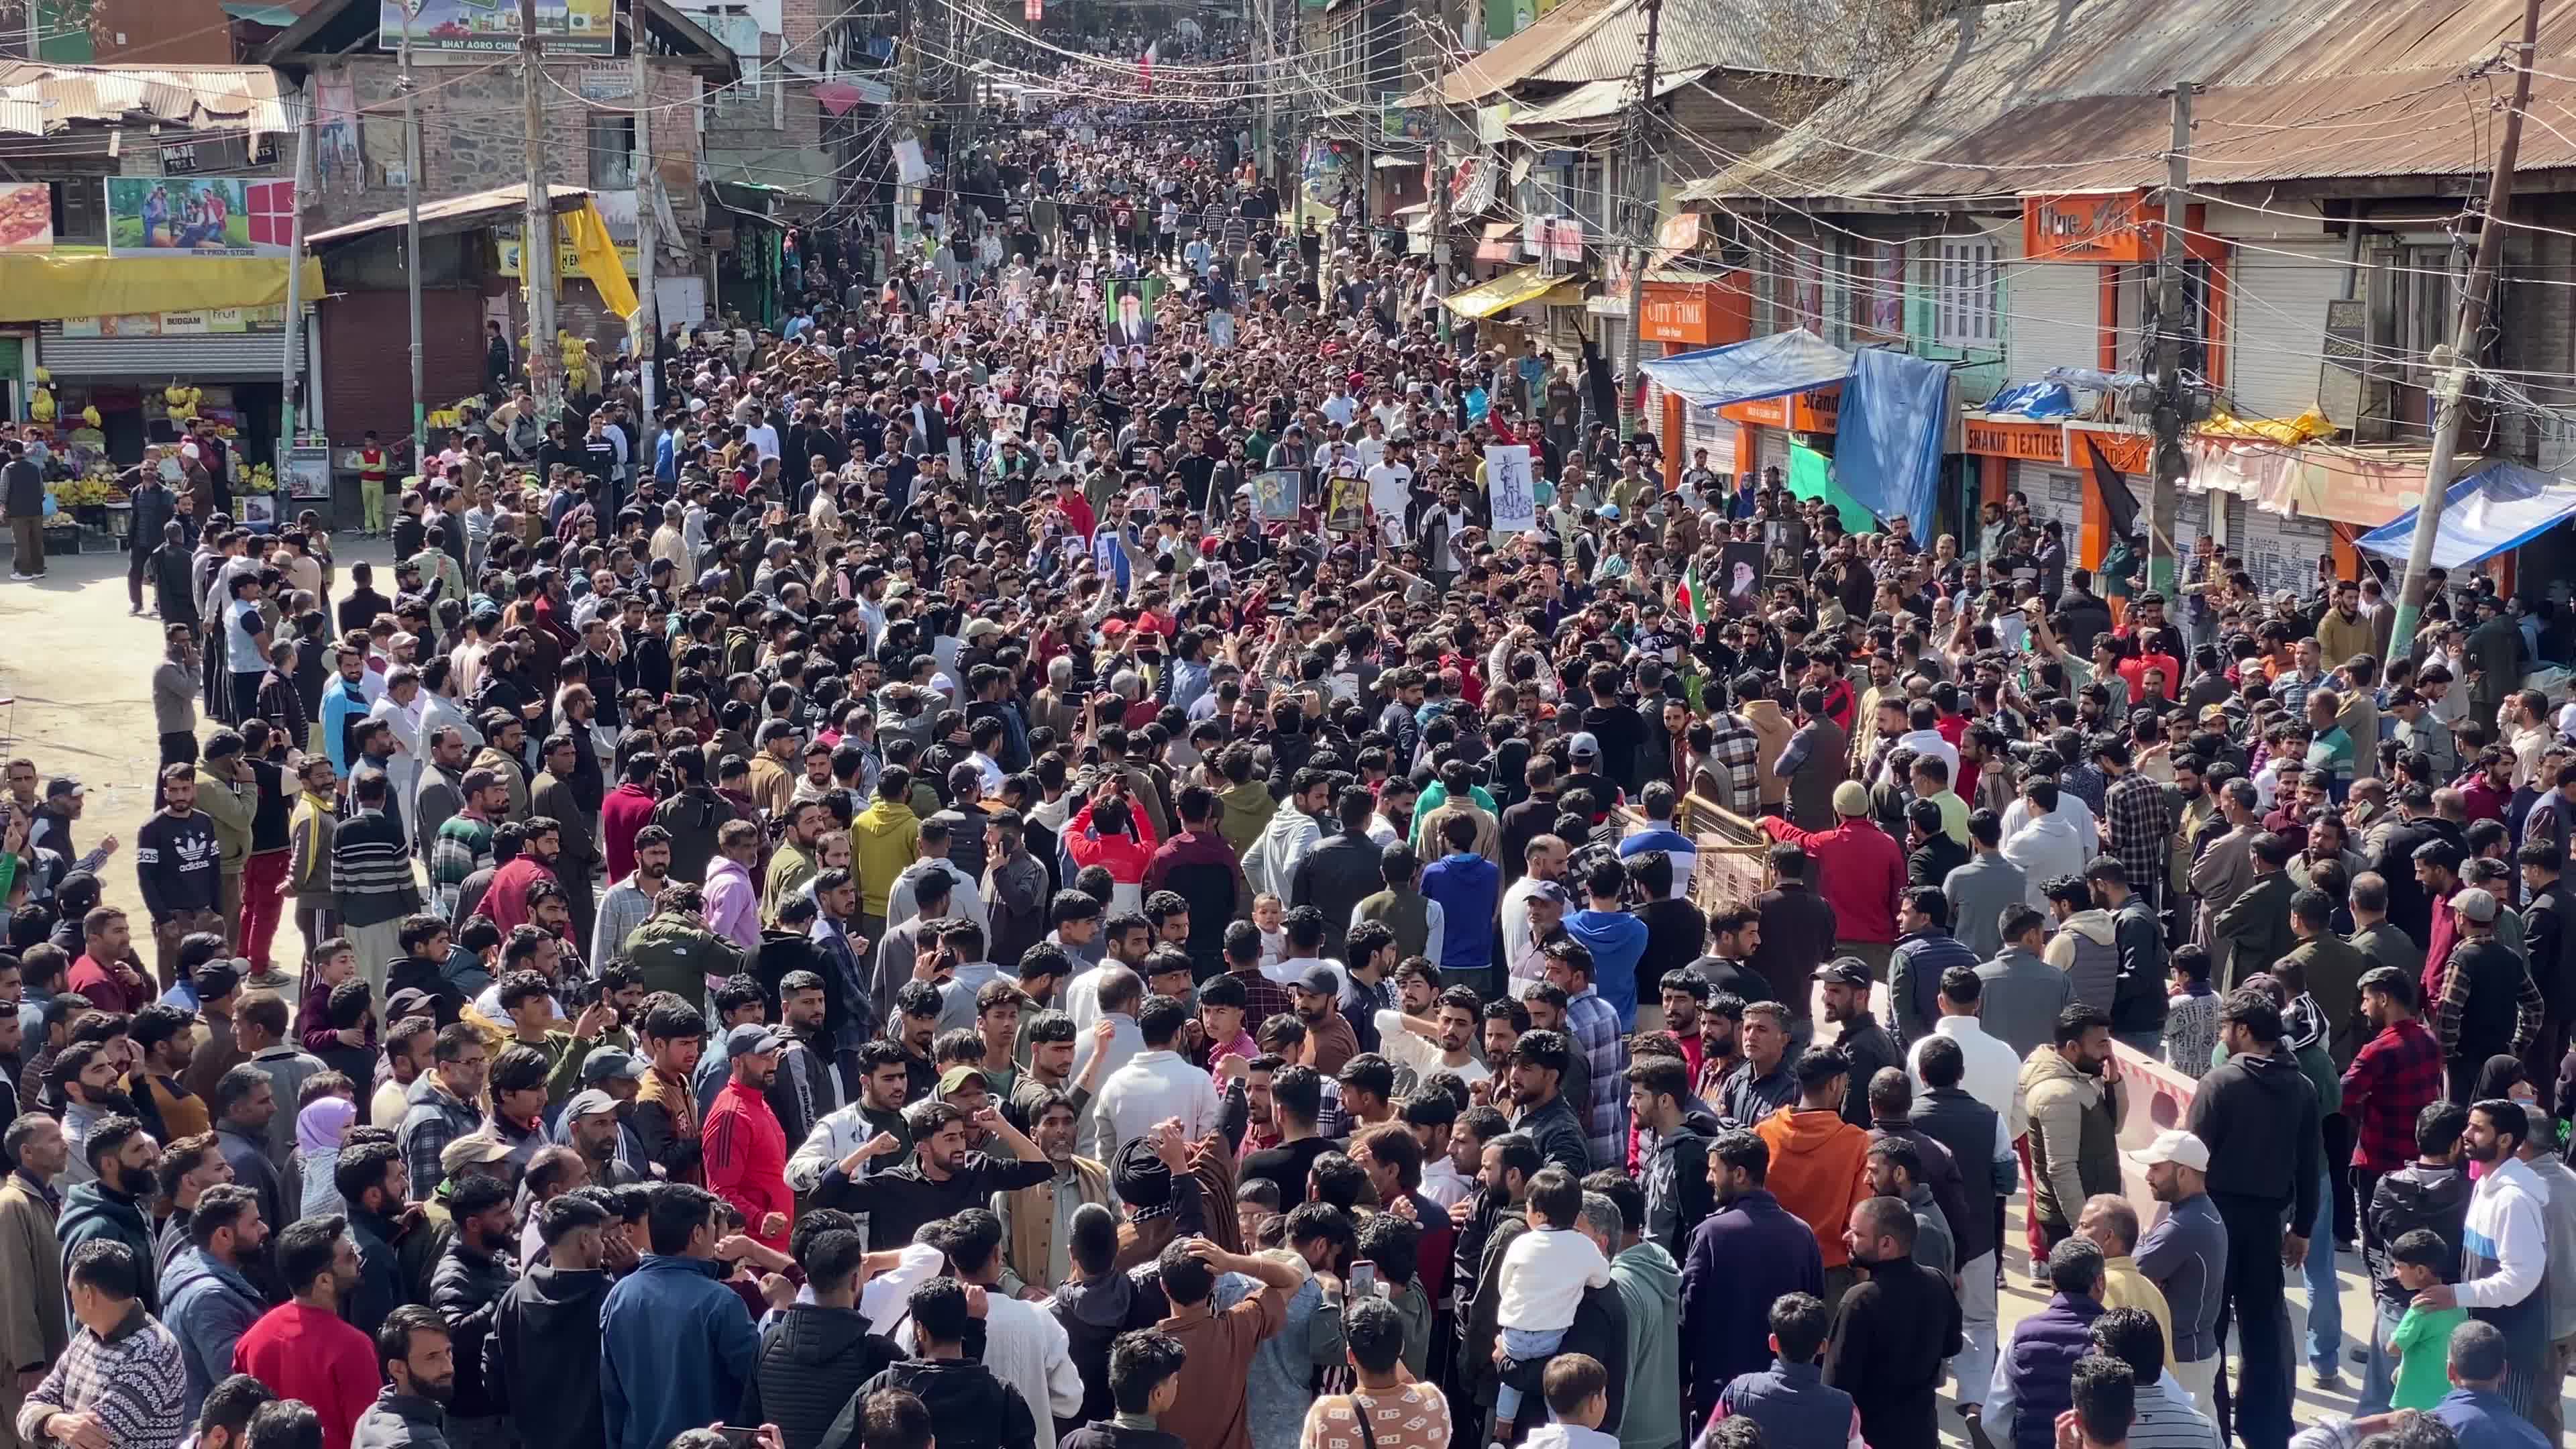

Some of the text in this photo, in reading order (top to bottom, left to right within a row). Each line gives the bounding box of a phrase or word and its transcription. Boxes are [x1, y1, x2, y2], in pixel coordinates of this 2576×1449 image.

[441, 40, 464, 49] BHAT
[466, 41, 493, 50] AGRO
[1648, 299, 1702, 323] CITY TIME
[167, 317, 201, 325] BUDGAM
[1968, 429, 2008, 451] SHAKIR
[178, 859, 210, 872] adidas
